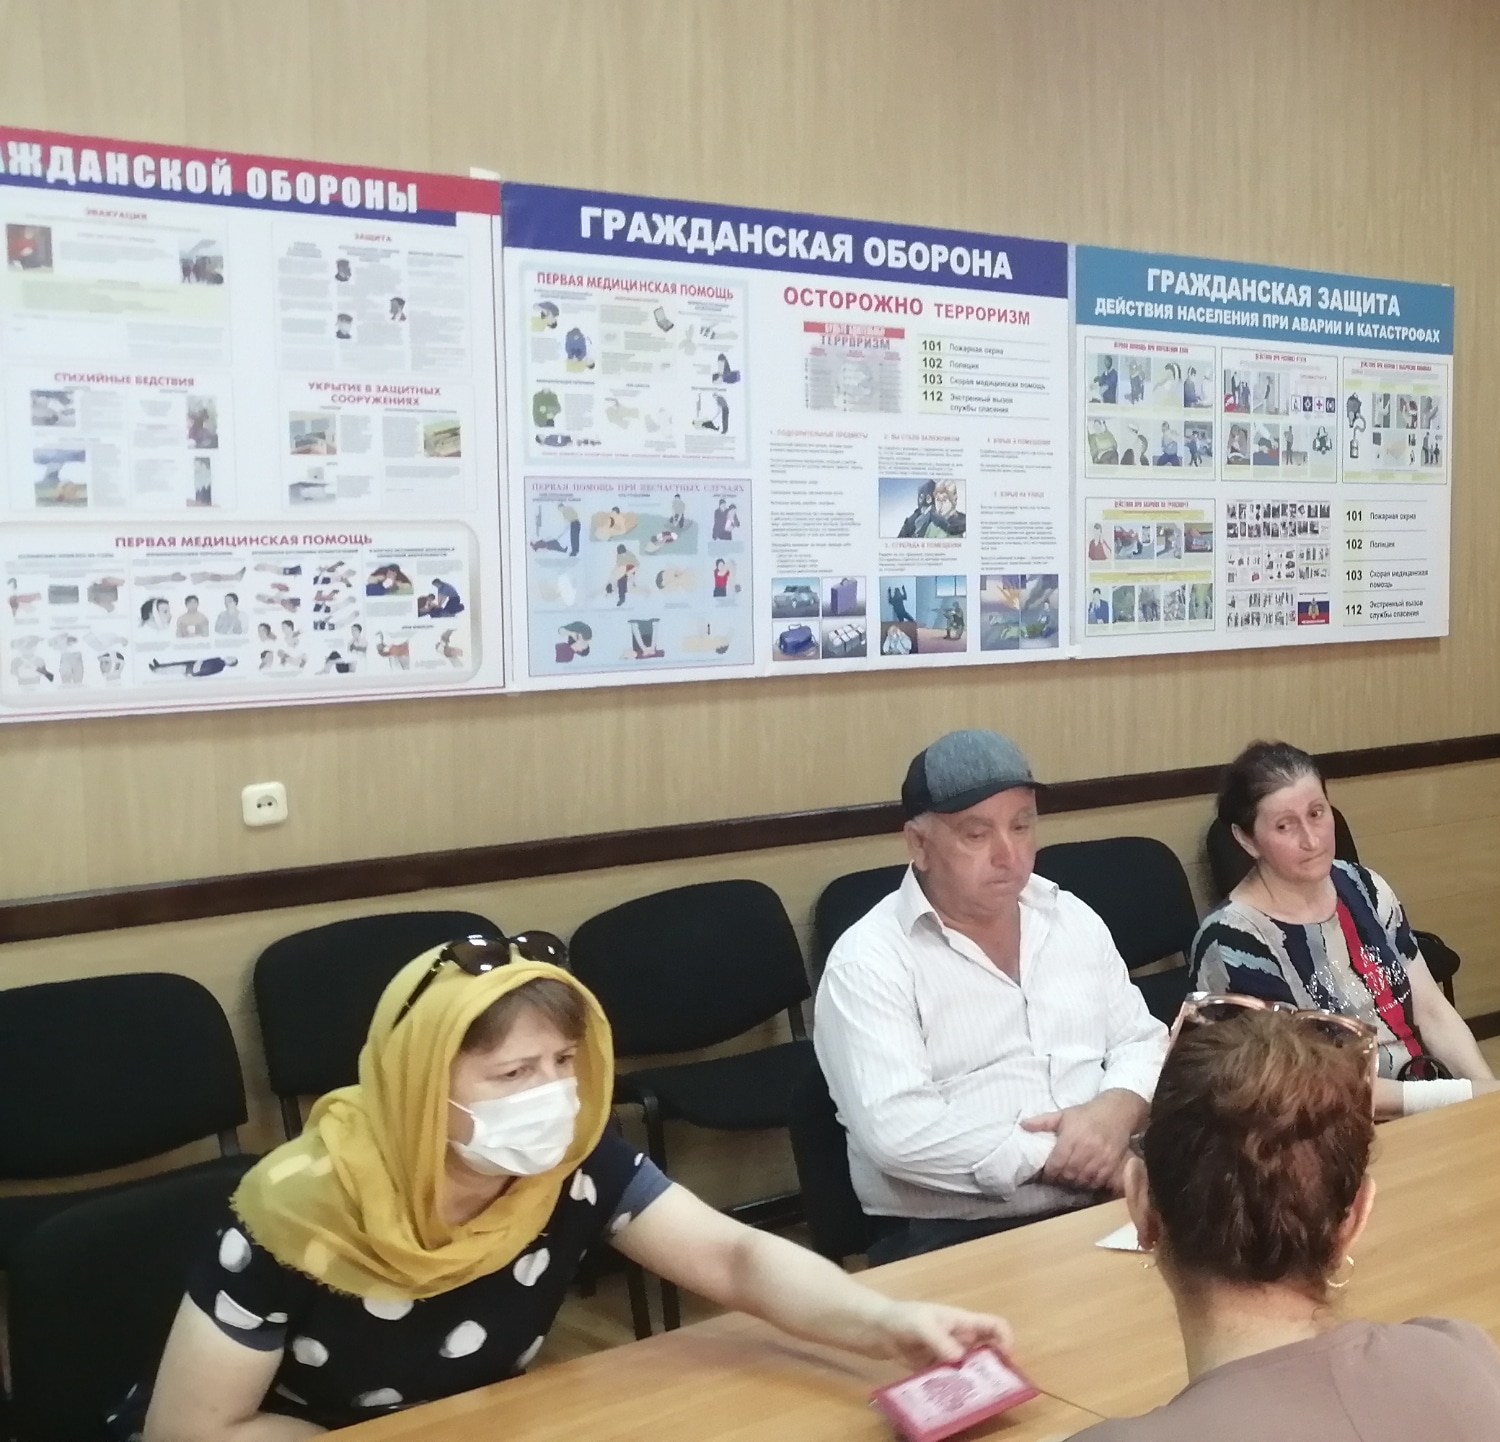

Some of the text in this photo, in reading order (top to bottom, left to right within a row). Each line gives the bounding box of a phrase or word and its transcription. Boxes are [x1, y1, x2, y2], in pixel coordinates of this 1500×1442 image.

[0, 141, 418, 213] ЖДАНСКОЙ ОБОРОНЫ
[580, 206, 1013, 280] ГРАЖДАНСКАЯ ОБОРОНА
[537, 271, 584, 287] ПЕРВАЯ
[586, 276, 677, 295] МЕДИЦИНСКАЯ
[679, 285, 734, 302] ПОМОЩЬ
[1147, 267, 1401, 317] ГРАЖДАНСКАЯ ЗАЩИТА
[783, 286, 1031, 325] ОСТОРОЖНО ТЕРРОРИЗМ
[1094, 296, 1441, 343] ДЕЙСТВИЯ НАСЕЛЕНИЯ ПРИ АВАРИИ И КАТАСТРОФАХ
[820, 335, 891, 350] ТЕРРОРИЗМ
[921, 340, 942, 351] 101
[922, 357, 943, 369] 102
[54, 372, 195, 387] СТИХИЙНЫЕ БЕДСТВИЯ
[922, 373, 943, 385] 103
[308, 382, 441, 396] УКРЫТИЕ В ЗАЩИТНЫХ
[922, 390, 943, 402] 112
[331, 394, 420, 406] СООРУЖЕНИЯХ
[1346, 510, 1362, 521] 101
[115, 534, 373, 549] ПЕРВАЯ МЕДИЦИНСКАЯ ПОМОЩЬ
[1346, 539, 1395, 550] 102 Полиция
[1346, 569, 1362, 581] 103
[1345, 603, 1362, 615] 112
